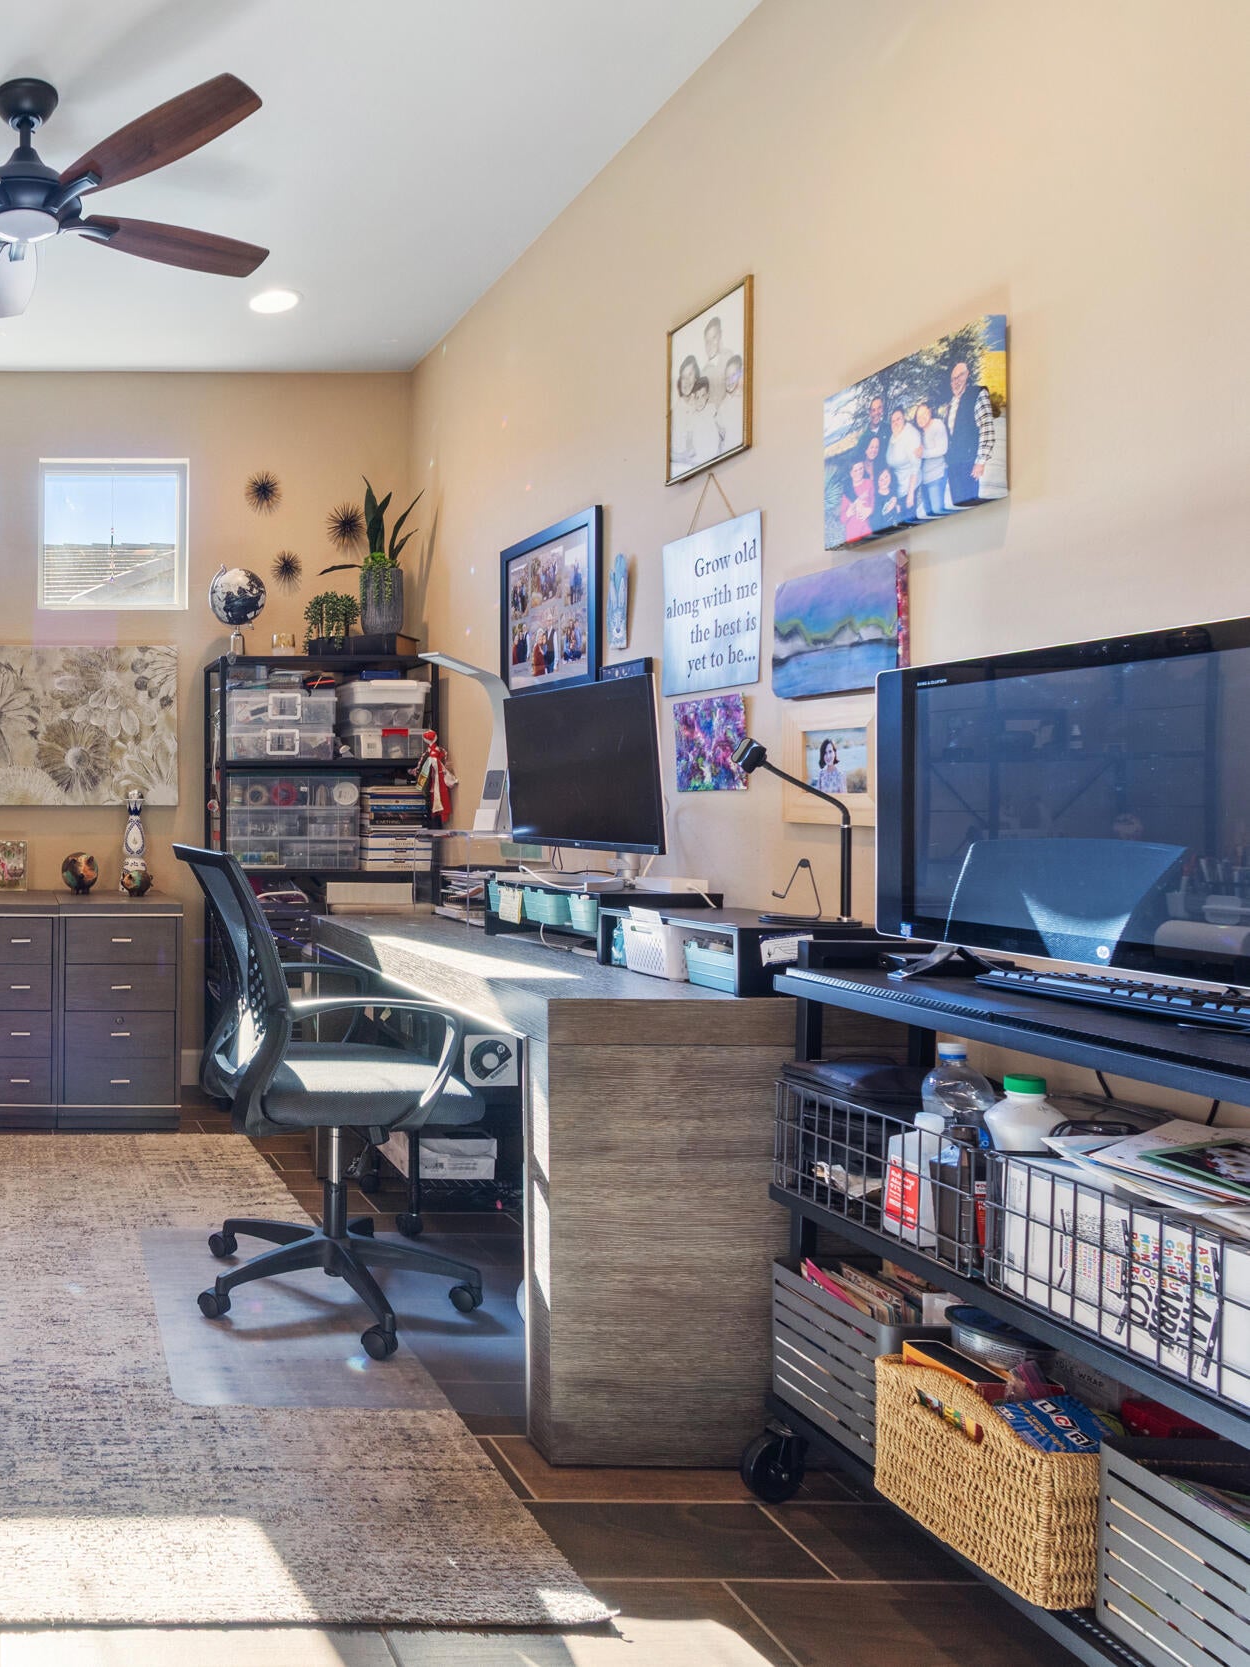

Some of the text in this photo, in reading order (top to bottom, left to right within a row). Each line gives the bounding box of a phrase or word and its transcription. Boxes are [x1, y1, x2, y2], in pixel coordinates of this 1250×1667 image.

[694, 538, 758, 578] Grow old
[666, 581, 758, 619] along with me
[690, 611, 757, 644] the best is
[687, 644, 756, 678] yet to be...
